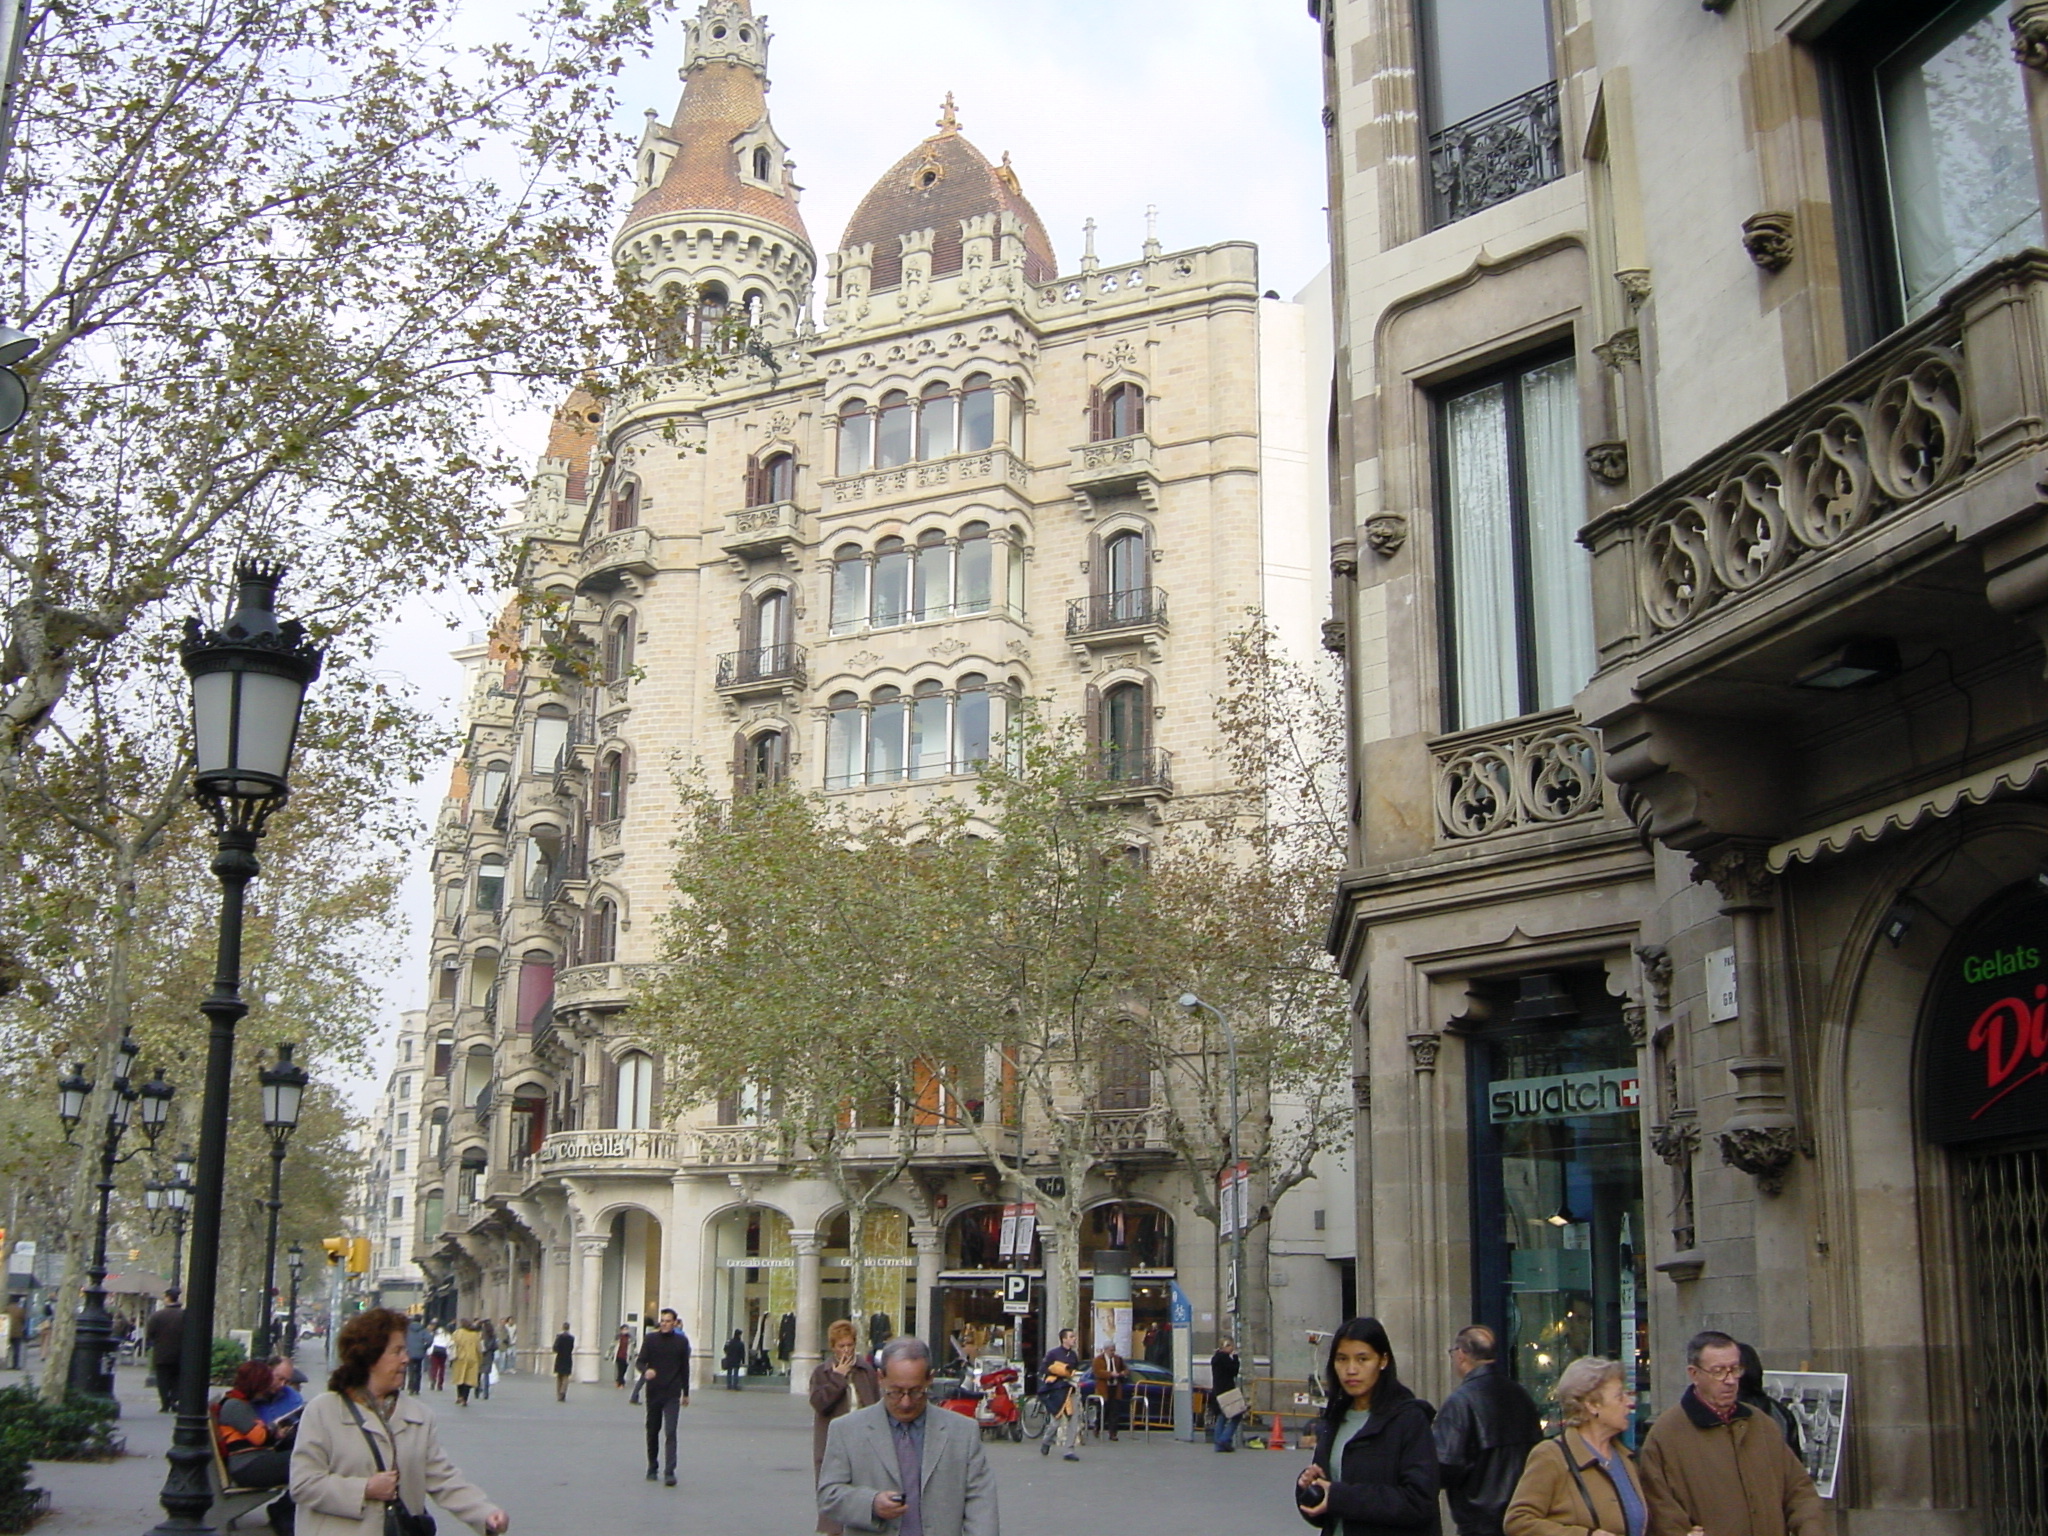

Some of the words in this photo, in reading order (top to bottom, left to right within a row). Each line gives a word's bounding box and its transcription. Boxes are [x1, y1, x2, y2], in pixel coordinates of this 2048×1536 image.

[1963, 945, 2040, 984] Gelats
[1492, 1075, 1621, 1118] swatch
[1008, 1276, 1026, 1300] P
